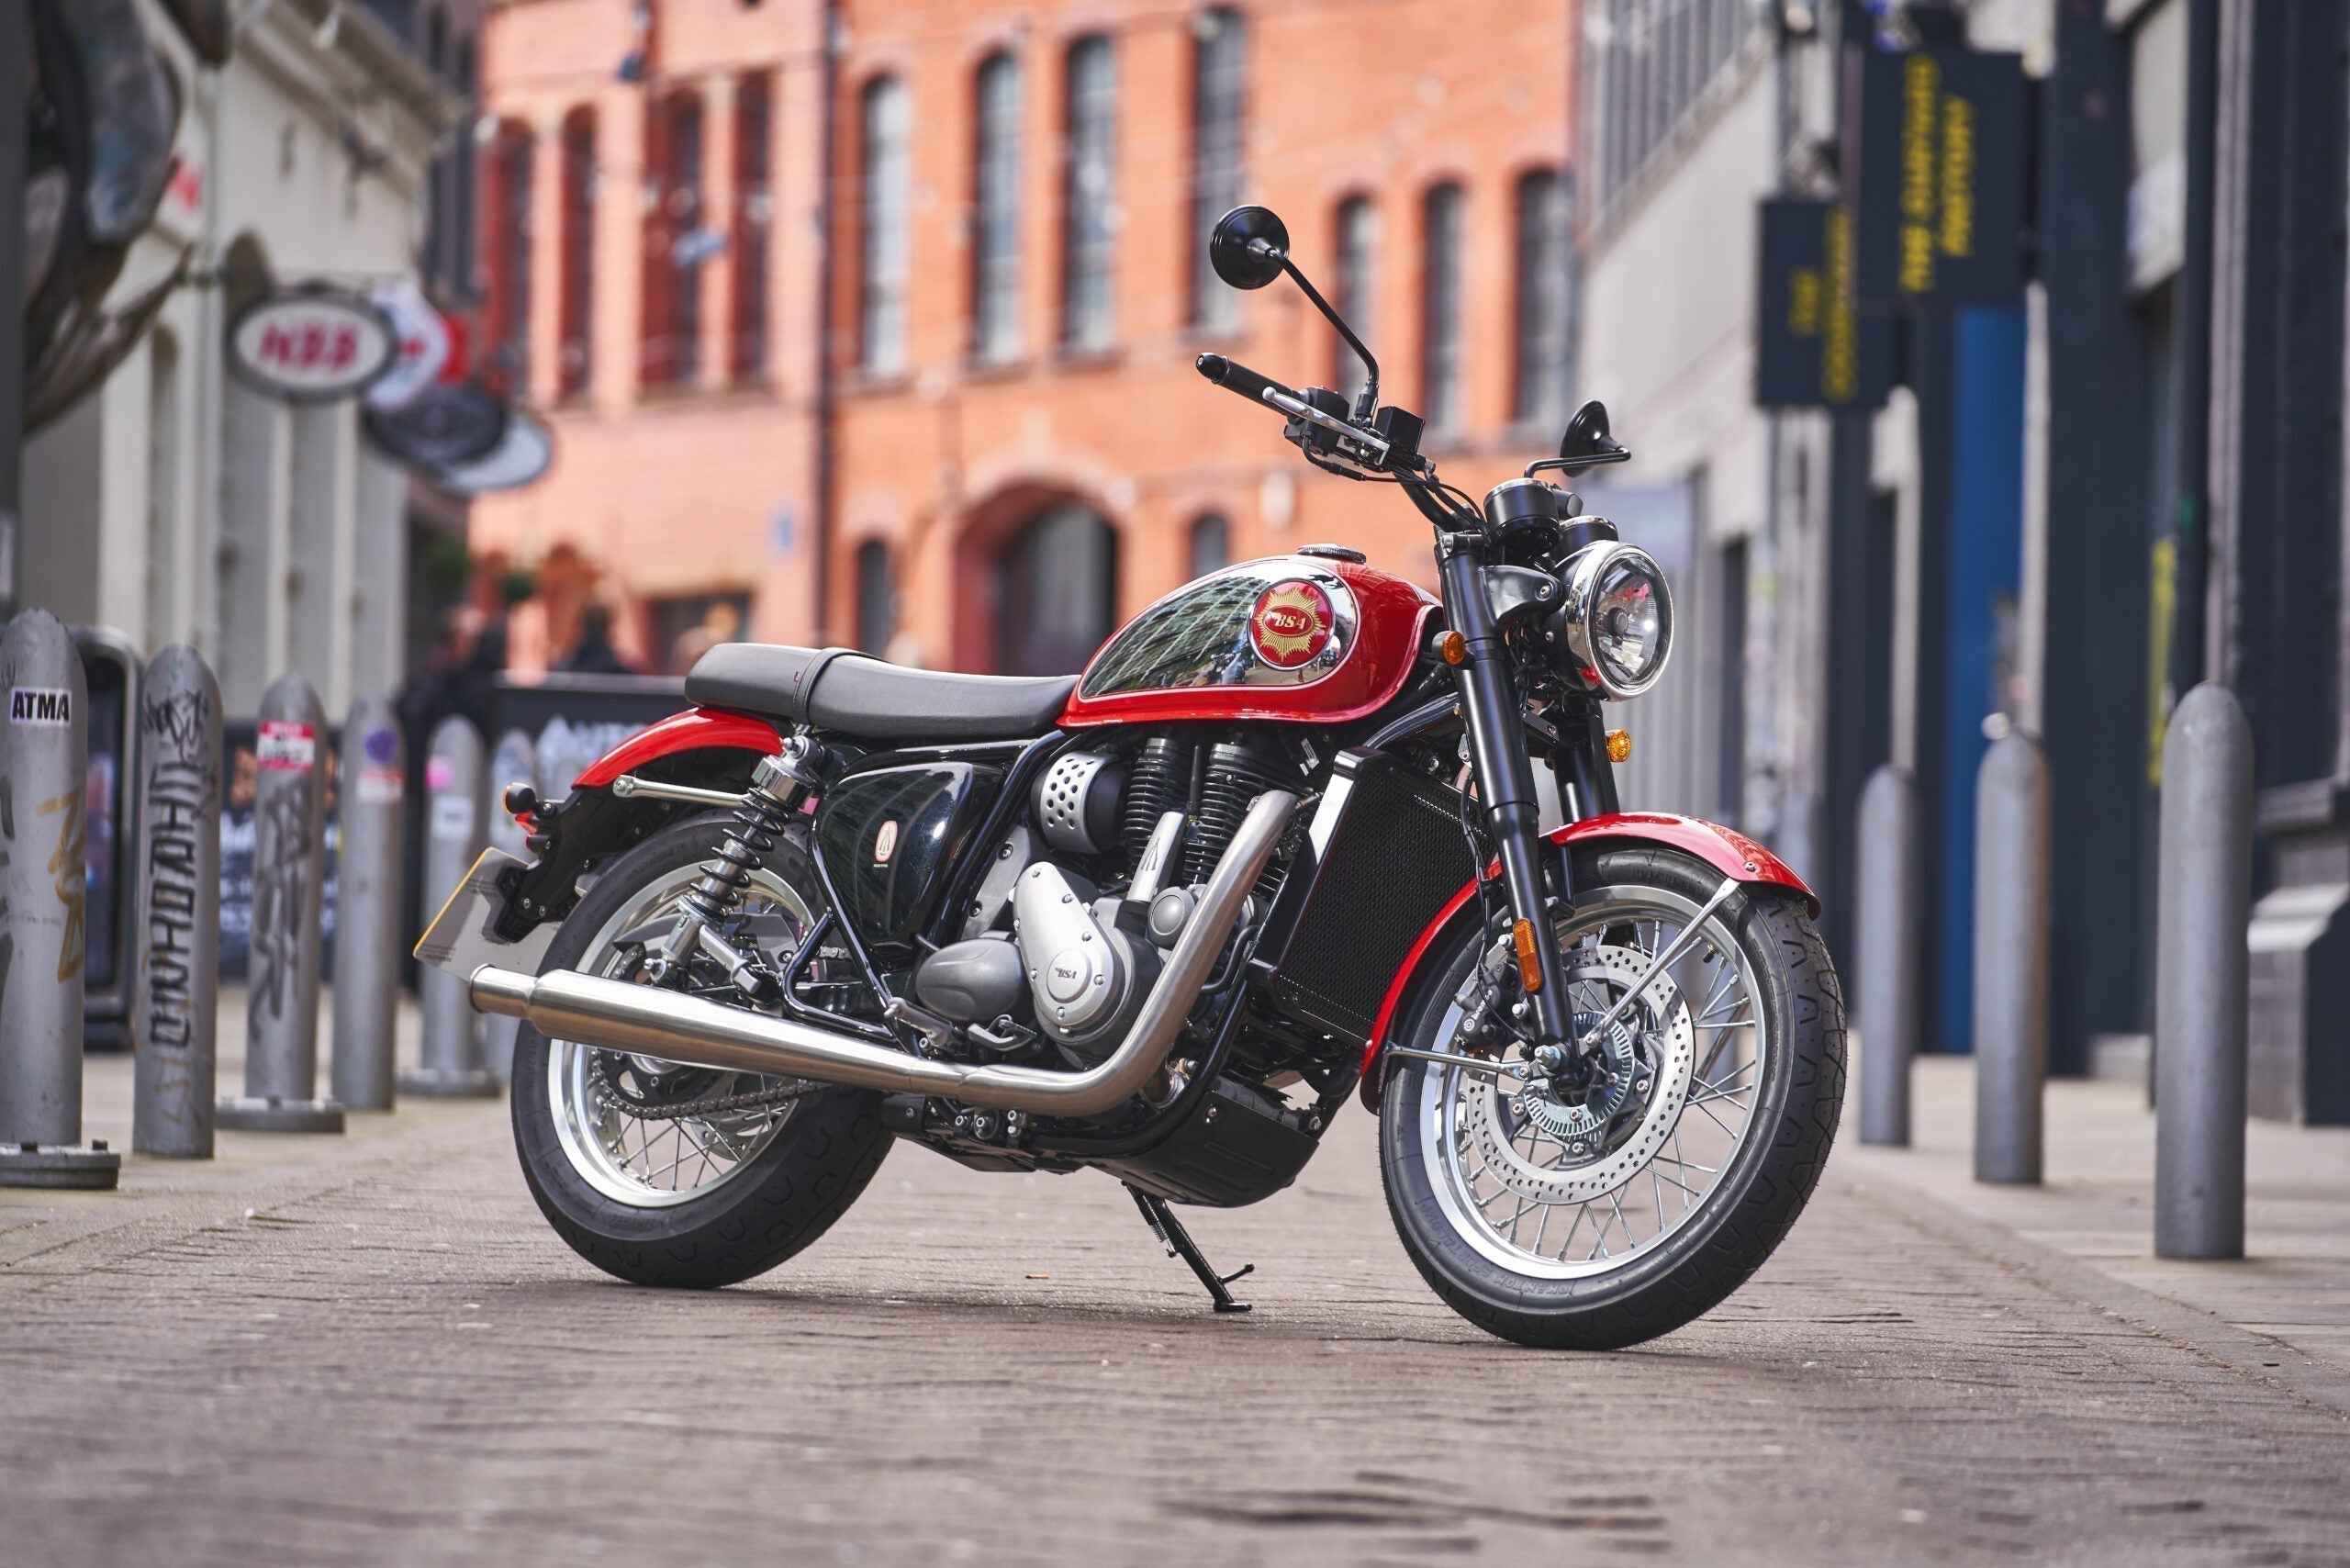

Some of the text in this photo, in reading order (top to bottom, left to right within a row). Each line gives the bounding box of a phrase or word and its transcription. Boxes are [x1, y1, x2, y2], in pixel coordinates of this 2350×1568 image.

[1272, 611, 1306, 630] BSA
[11, 691, 70, 722] ATMA
[1055, 968, 1078, 980] BSA
